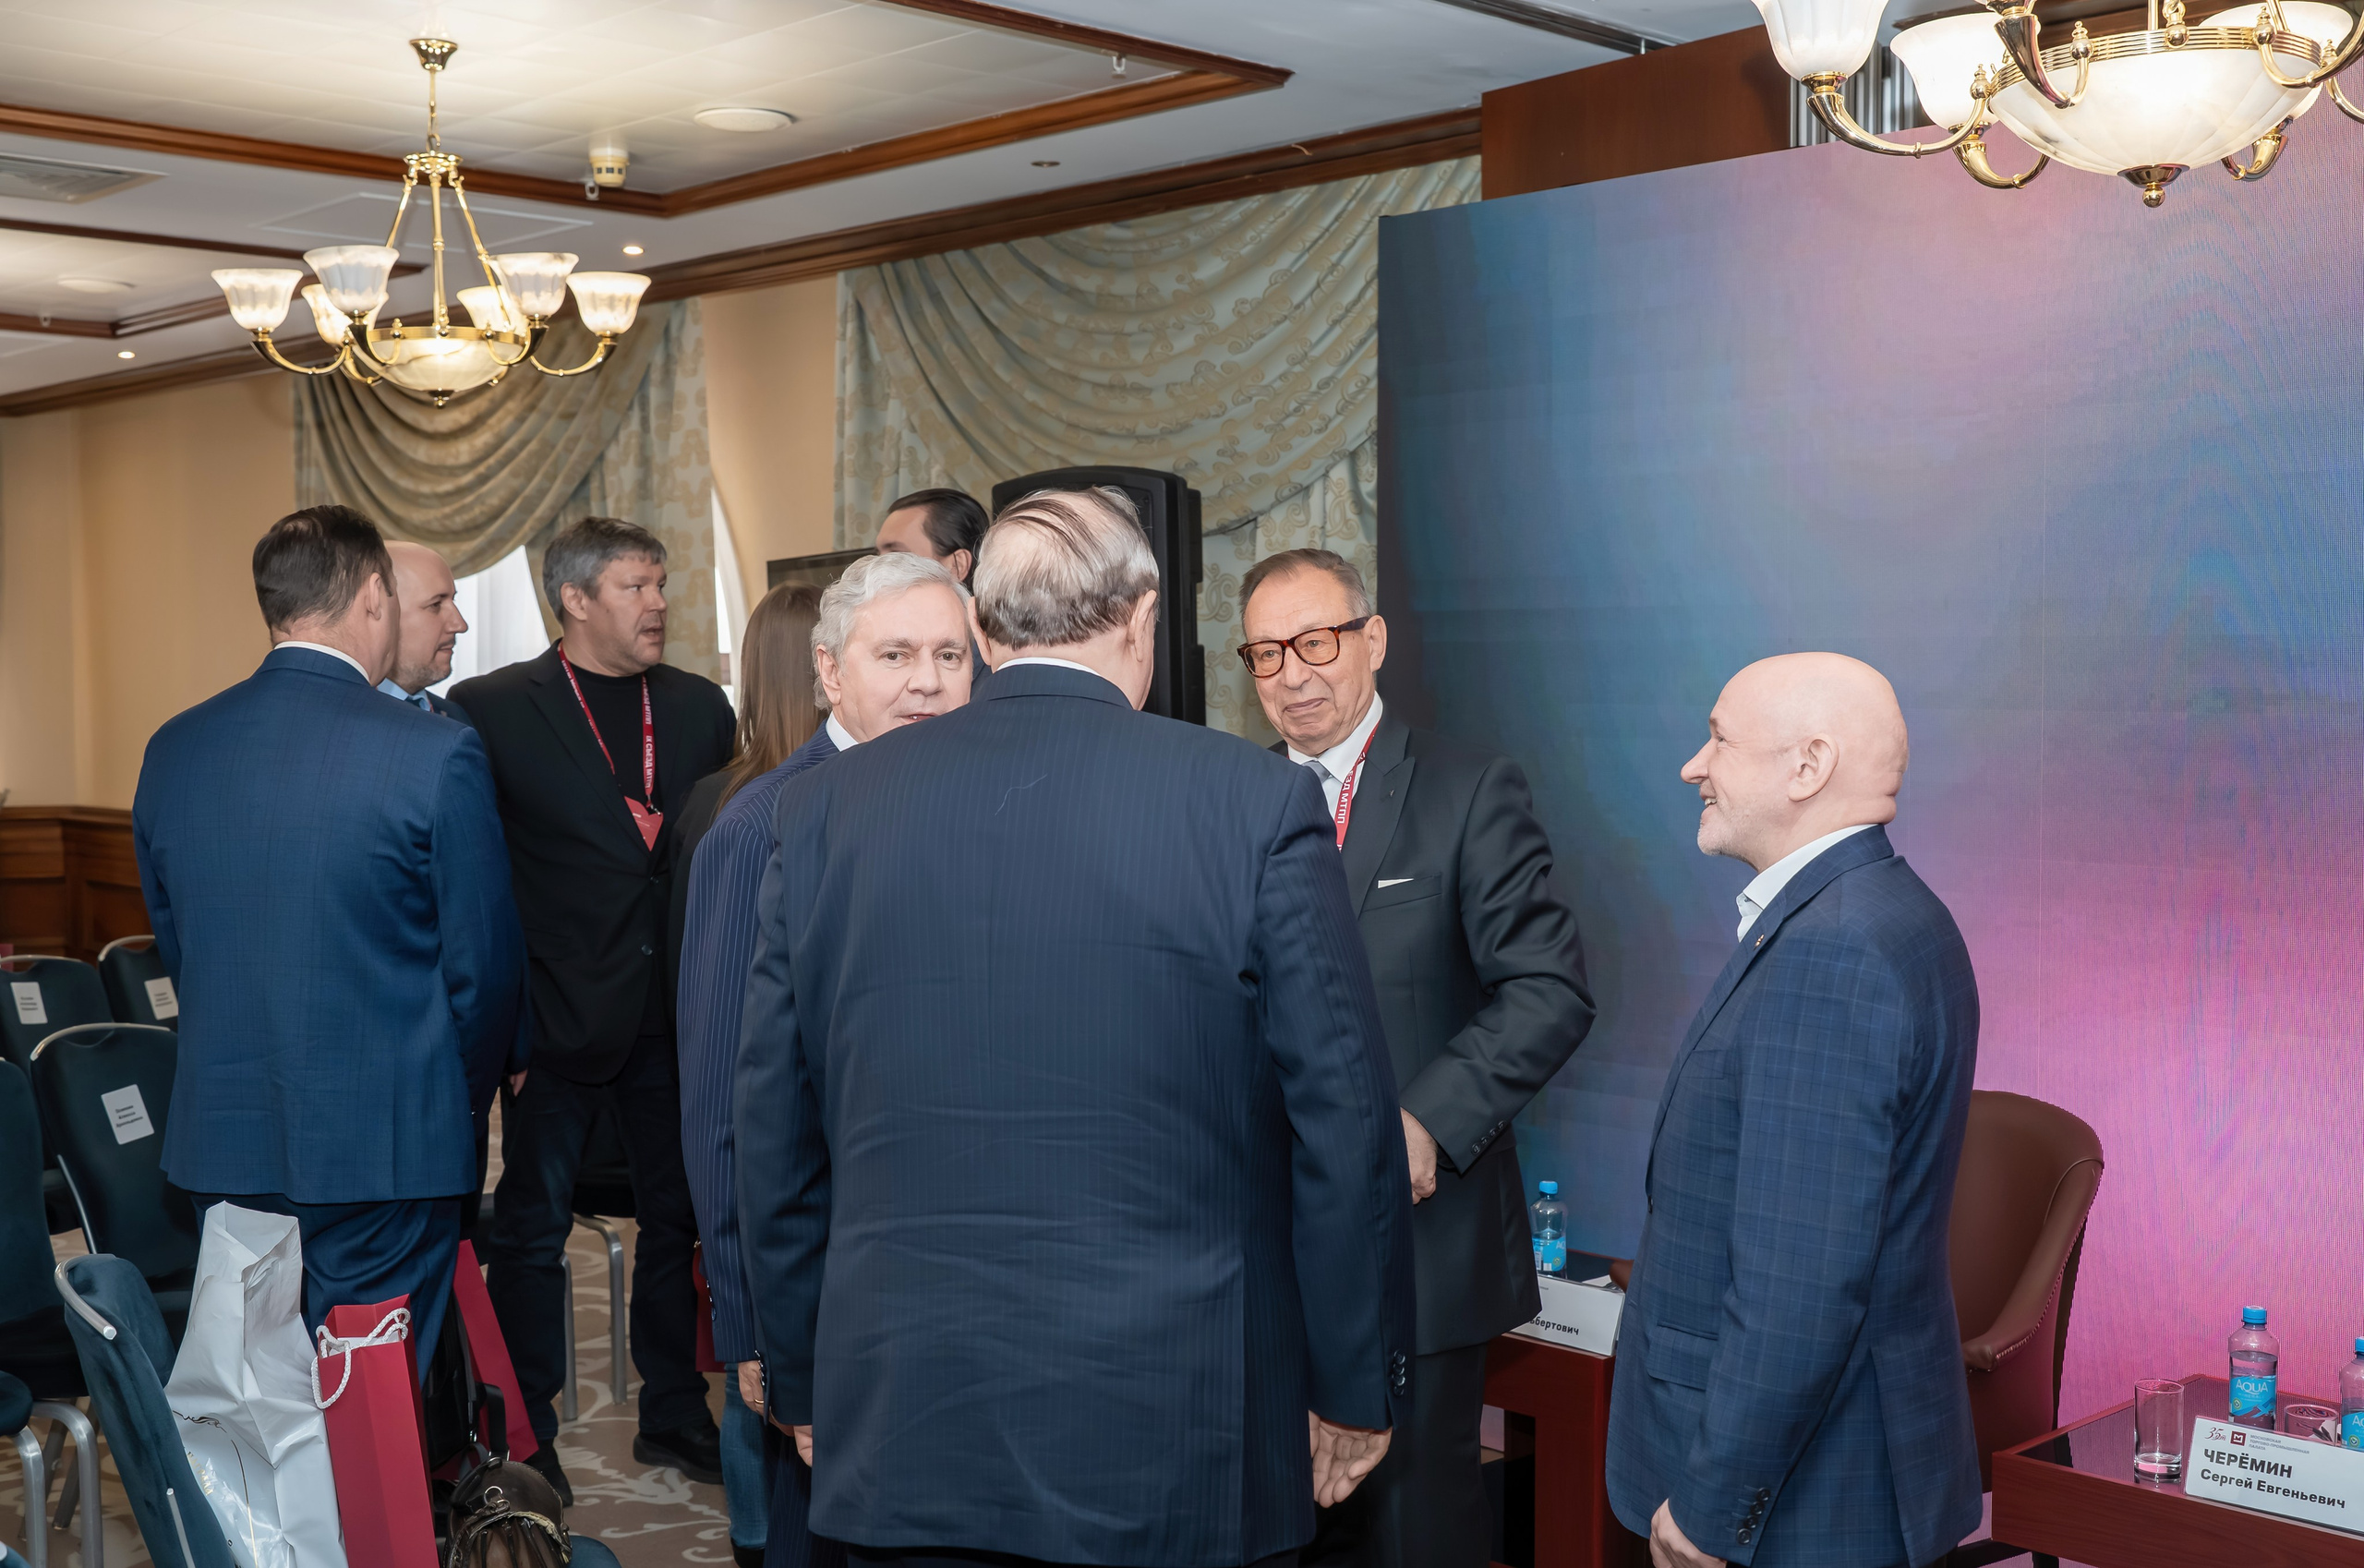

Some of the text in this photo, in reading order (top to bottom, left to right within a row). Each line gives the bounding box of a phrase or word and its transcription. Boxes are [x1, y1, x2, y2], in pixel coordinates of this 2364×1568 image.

[1336, 792, 1349, 825] МТПП
[2235, 1379, 2269, 1395] AQUA
[2249, 1434, 2282, 1443] МОСКОВСКАЯ
[2203, 1448, 2293, 1478] ЧЕРЁМИН
[2200, 1467, 2346, 1509] Сергей Евгеньевич
